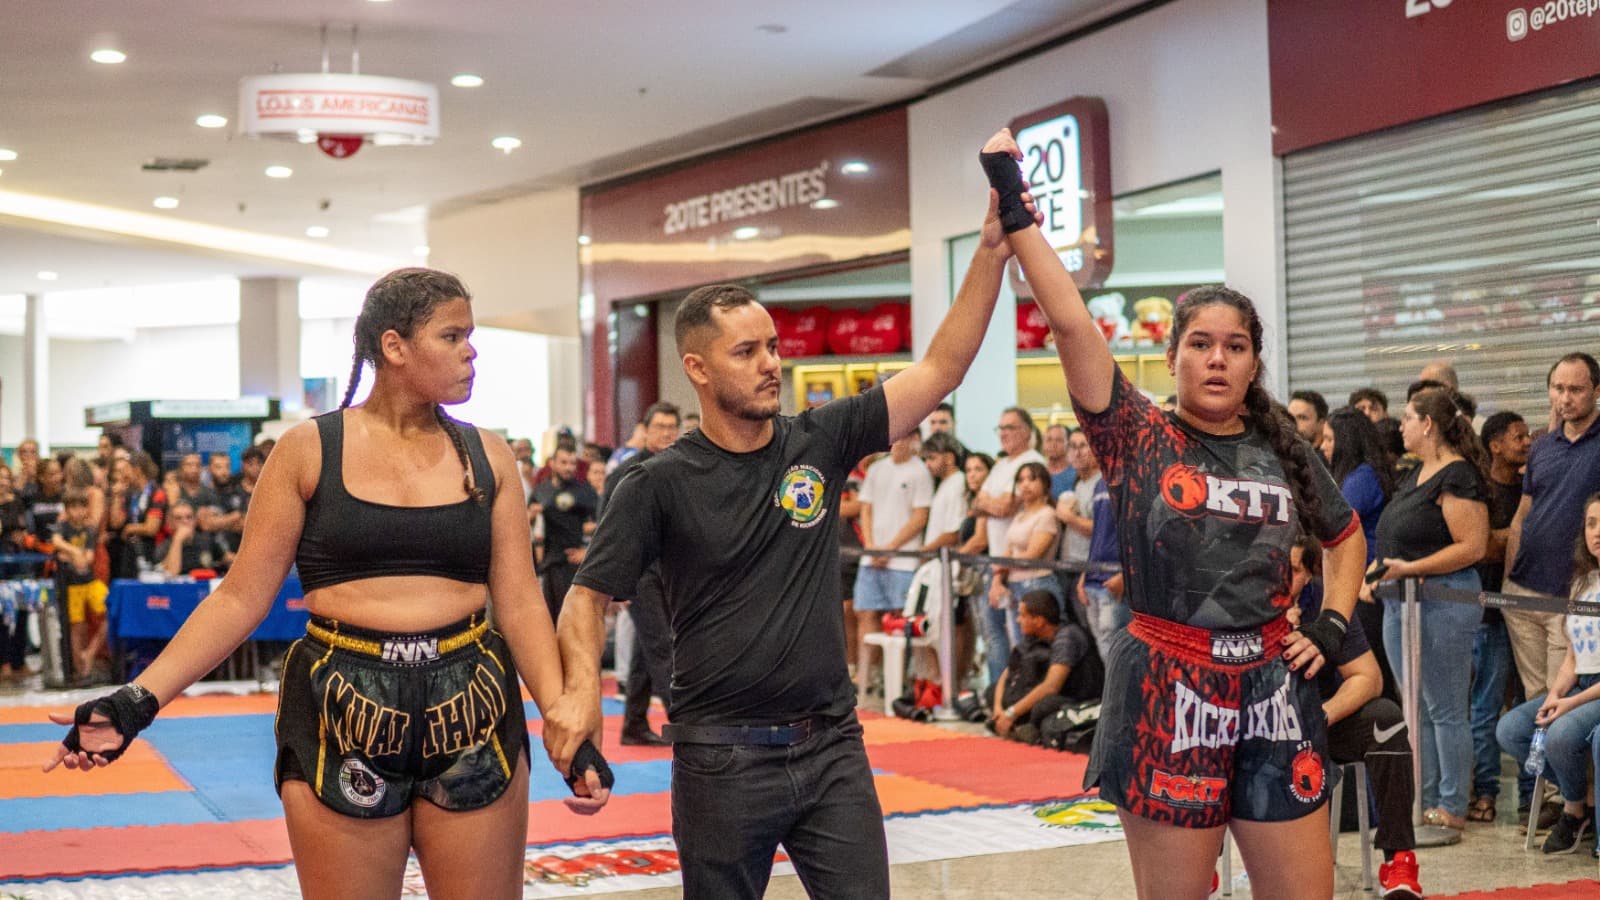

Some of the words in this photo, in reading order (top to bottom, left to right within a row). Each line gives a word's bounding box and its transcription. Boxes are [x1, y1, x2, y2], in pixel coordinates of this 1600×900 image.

[1530, 0, 1600, 31] @20tep
[258, 96, 315, 113] LOJS
[1206, 475, 1292, 522] KTT
